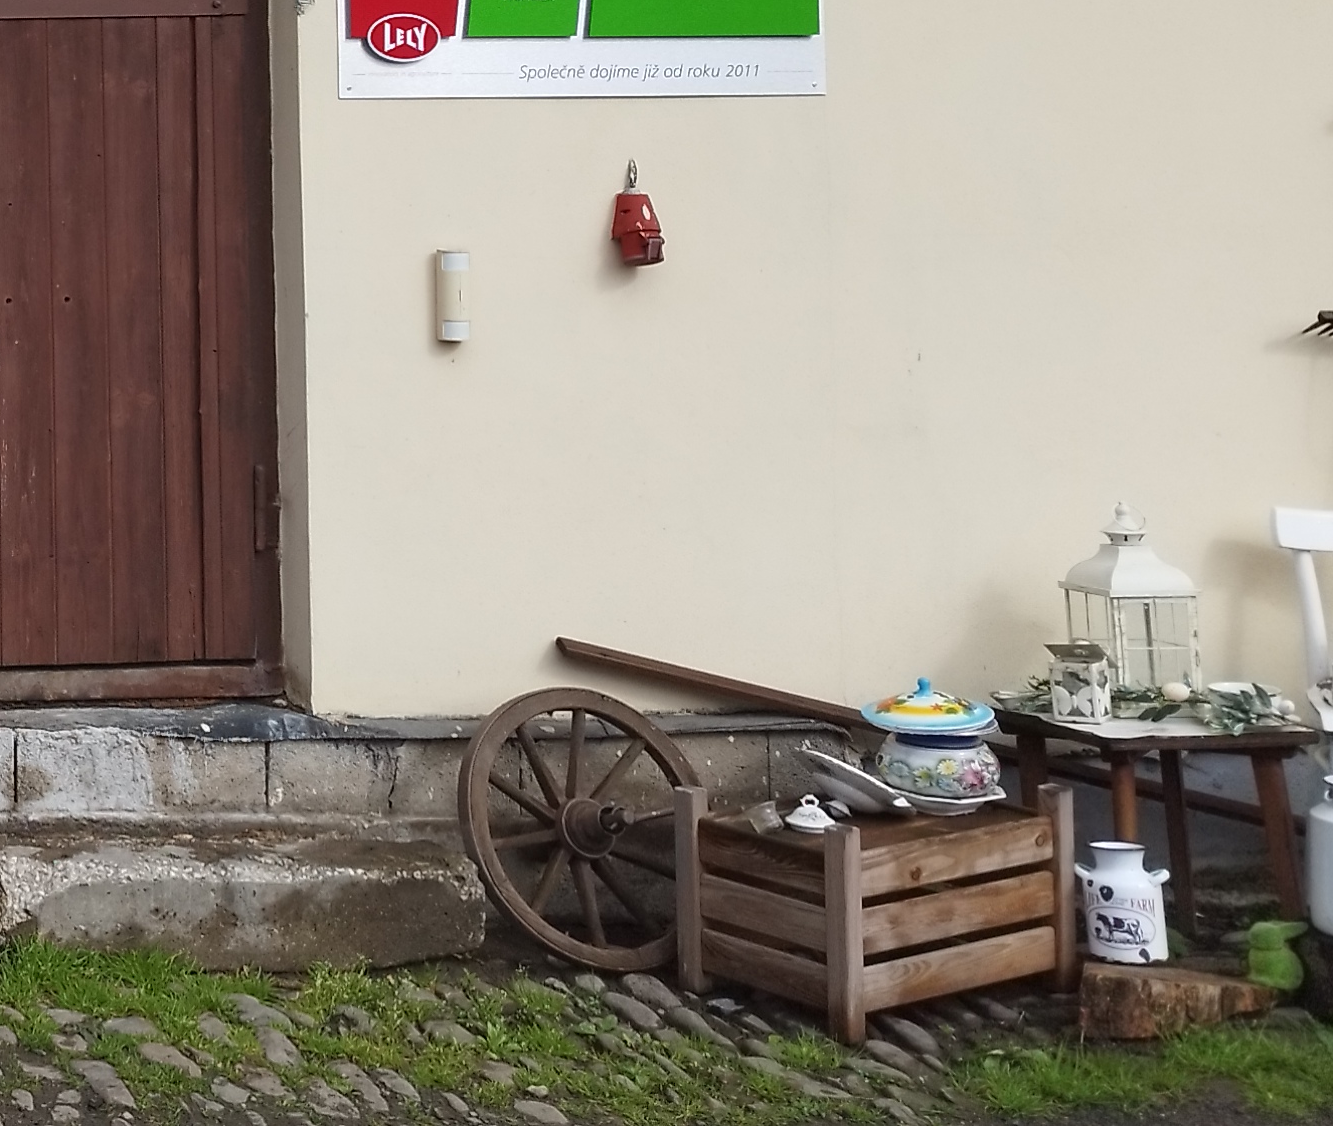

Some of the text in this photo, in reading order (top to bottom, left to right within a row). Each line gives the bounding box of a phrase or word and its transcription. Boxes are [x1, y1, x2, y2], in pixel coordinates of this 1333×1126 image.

[382, 22, 429, 54] LELY
[518, 64, 761, 83] Společně dojíme již od roku 2011
